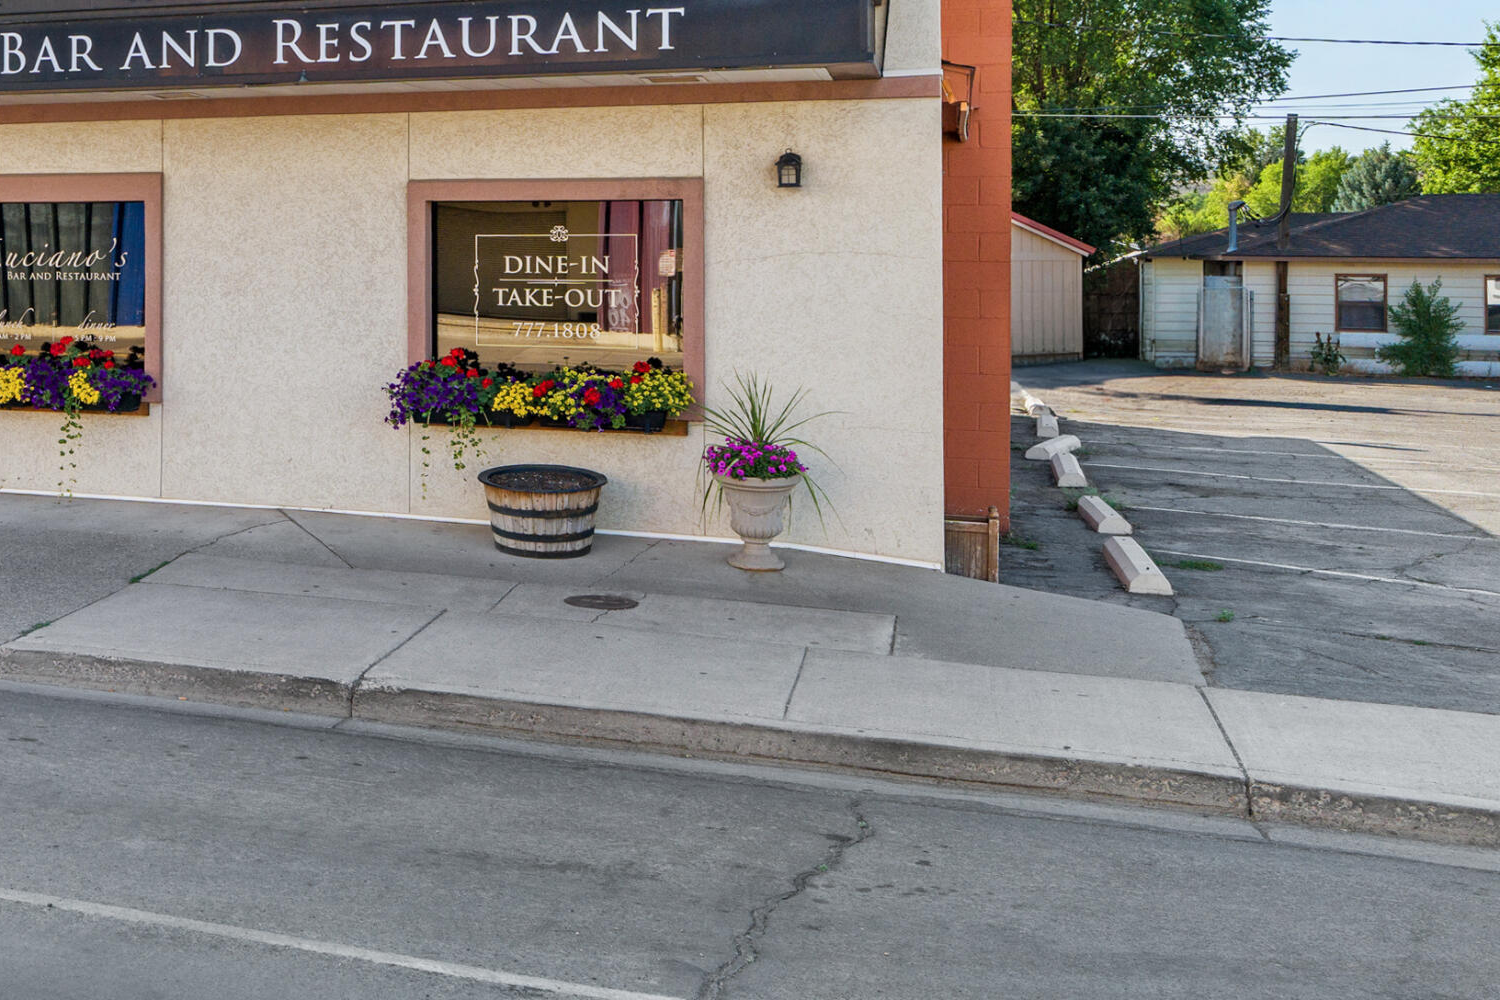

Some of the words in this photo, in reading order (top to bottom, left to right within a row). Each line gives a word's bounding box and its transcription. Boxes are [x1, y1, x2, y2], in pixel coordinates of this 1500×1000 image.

[0, 31, 103, 75] BAR
[118, 28, 244, 71] AND
[271, 6, 687, 66] RESTAURANT
[503, 255, 611, 274] DINE-IN
[7, 271, 26, 281] BAR
[29, 271, 51, 281] AND
[55, 271, 122, 281] RESTAURANT
[492, 288, 622, 308] TAKE-OUT
[77, 310, 116, 330] dinner
[512, 322, 601, 339] 777.1808
